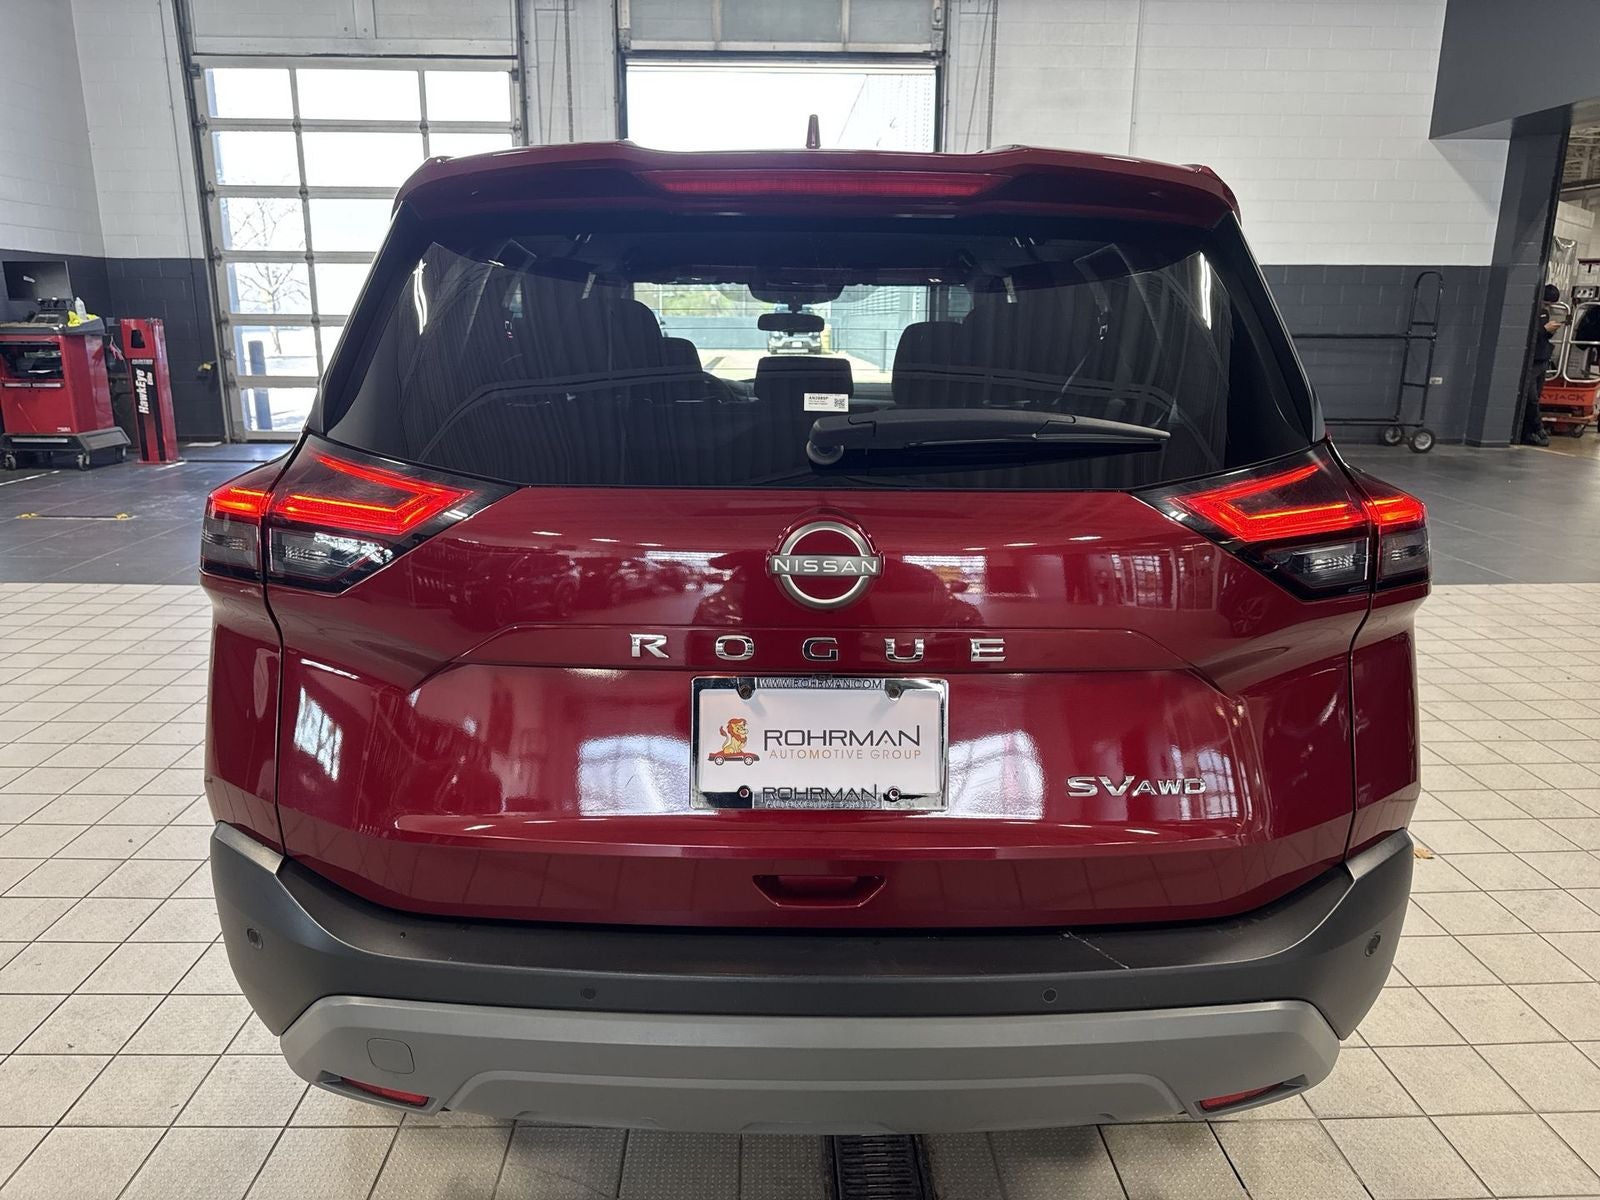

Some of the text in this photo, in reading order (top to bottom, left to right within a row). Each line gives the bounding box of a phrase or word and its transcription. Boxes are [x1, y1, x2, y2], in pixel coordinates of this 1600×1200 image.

[135, 368, 150, 415] HawkEye
[774, 558, 877, 573] NISSAN
[630, 632, 1007, 663] ROGUE
[759, 679, 882, 690] WWW.ROHRMAN.COM
[763, 725, 921, 751] ROHRMAN
[769, 749, 922, 760] AUTOMOTIVE GROUP
[762, 784, 878, 803] ROHRMAN
[1067, 775, 1208, 797] SV AWD
